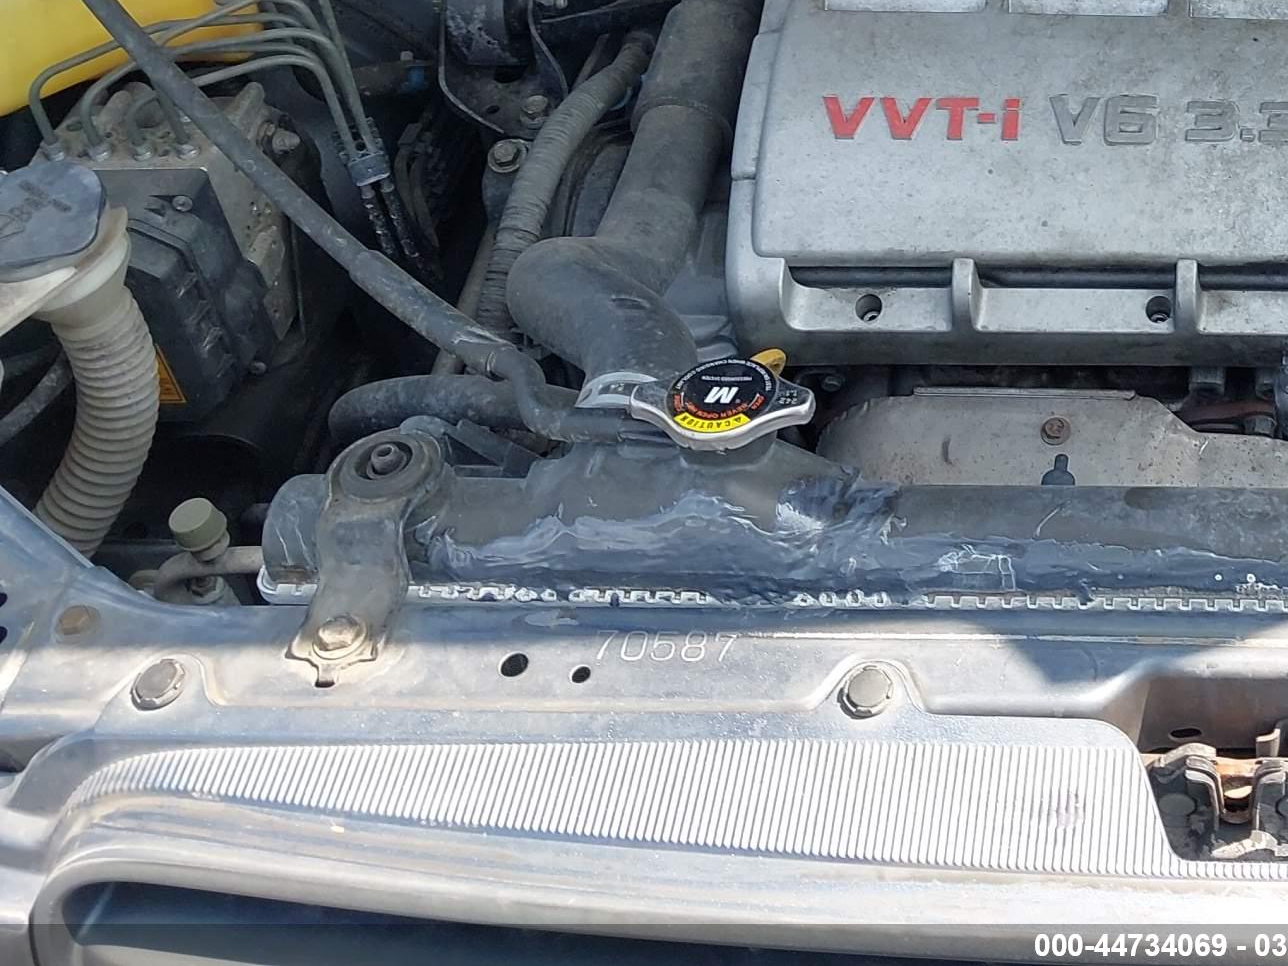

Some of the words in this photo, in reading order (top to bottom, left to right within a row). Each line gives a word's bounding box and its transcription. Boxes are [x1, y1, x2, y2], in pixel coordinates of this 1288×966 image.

[822, 95, 1021, 141] VVT-i
[1049, 93, 1159, 145] V6
[679, 415, 731, 429] CAUTION
[595, 629, 738, 662] 70587
